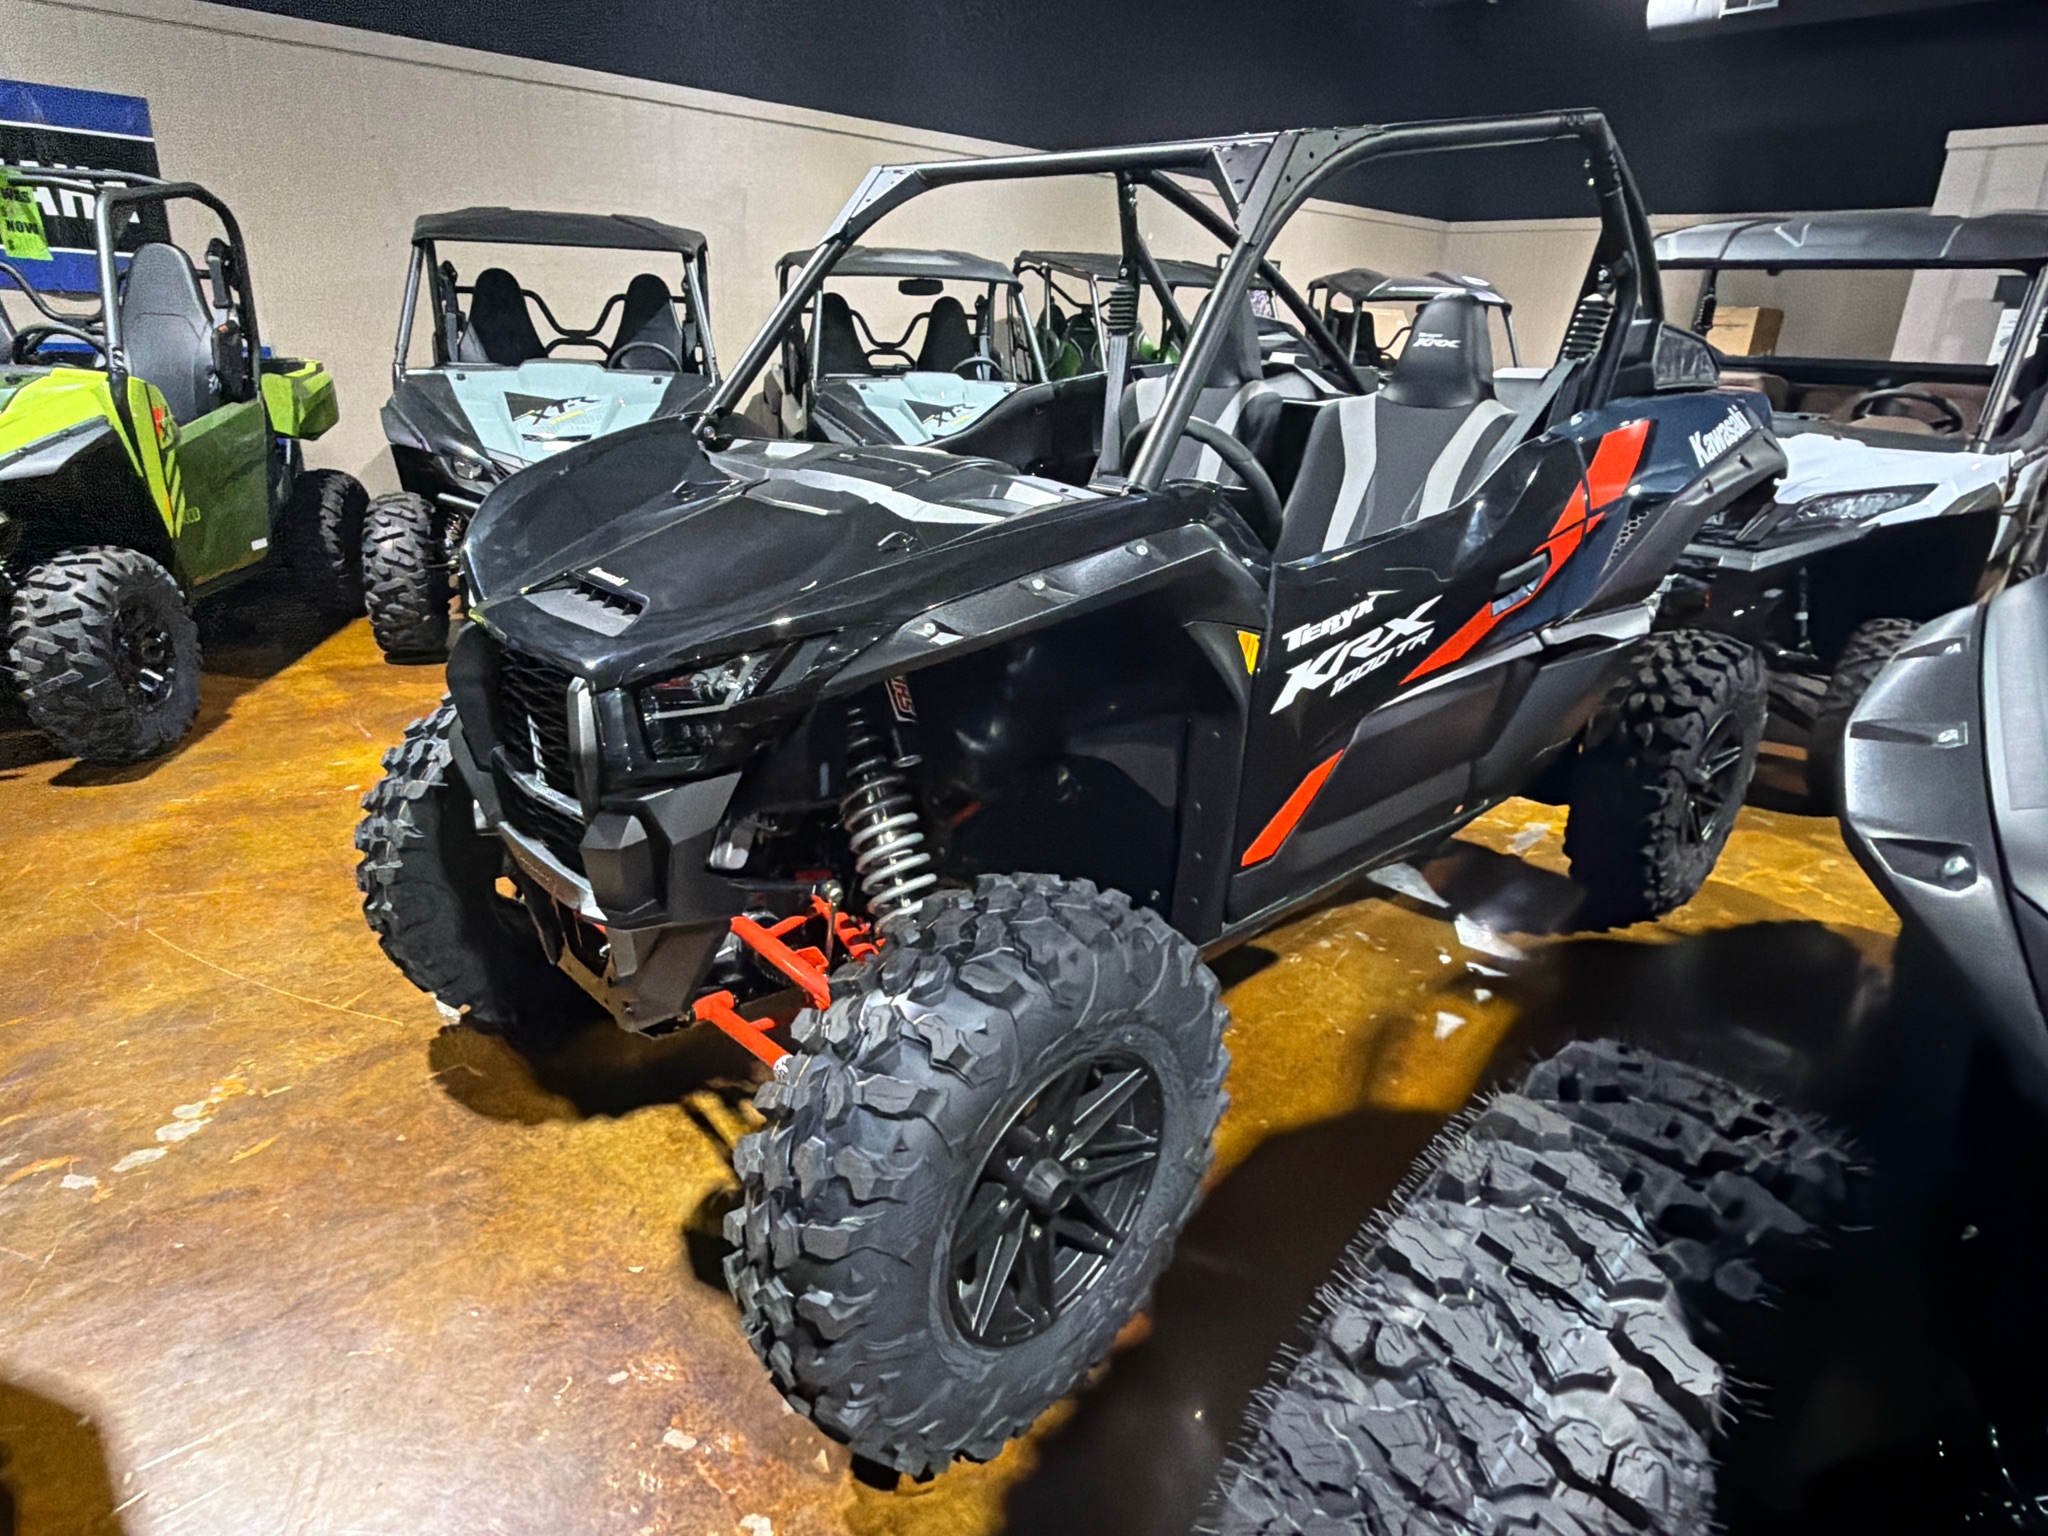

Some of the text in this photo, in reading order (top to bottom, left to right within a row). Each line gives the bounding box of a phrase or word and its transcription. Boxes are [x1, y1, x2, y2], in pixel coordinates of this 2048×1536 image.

[6, 220, 40, 235] NOW
[1688, 404, 1752, 469] Kawasaki
[1269, 594, 1444, 715] KRX
